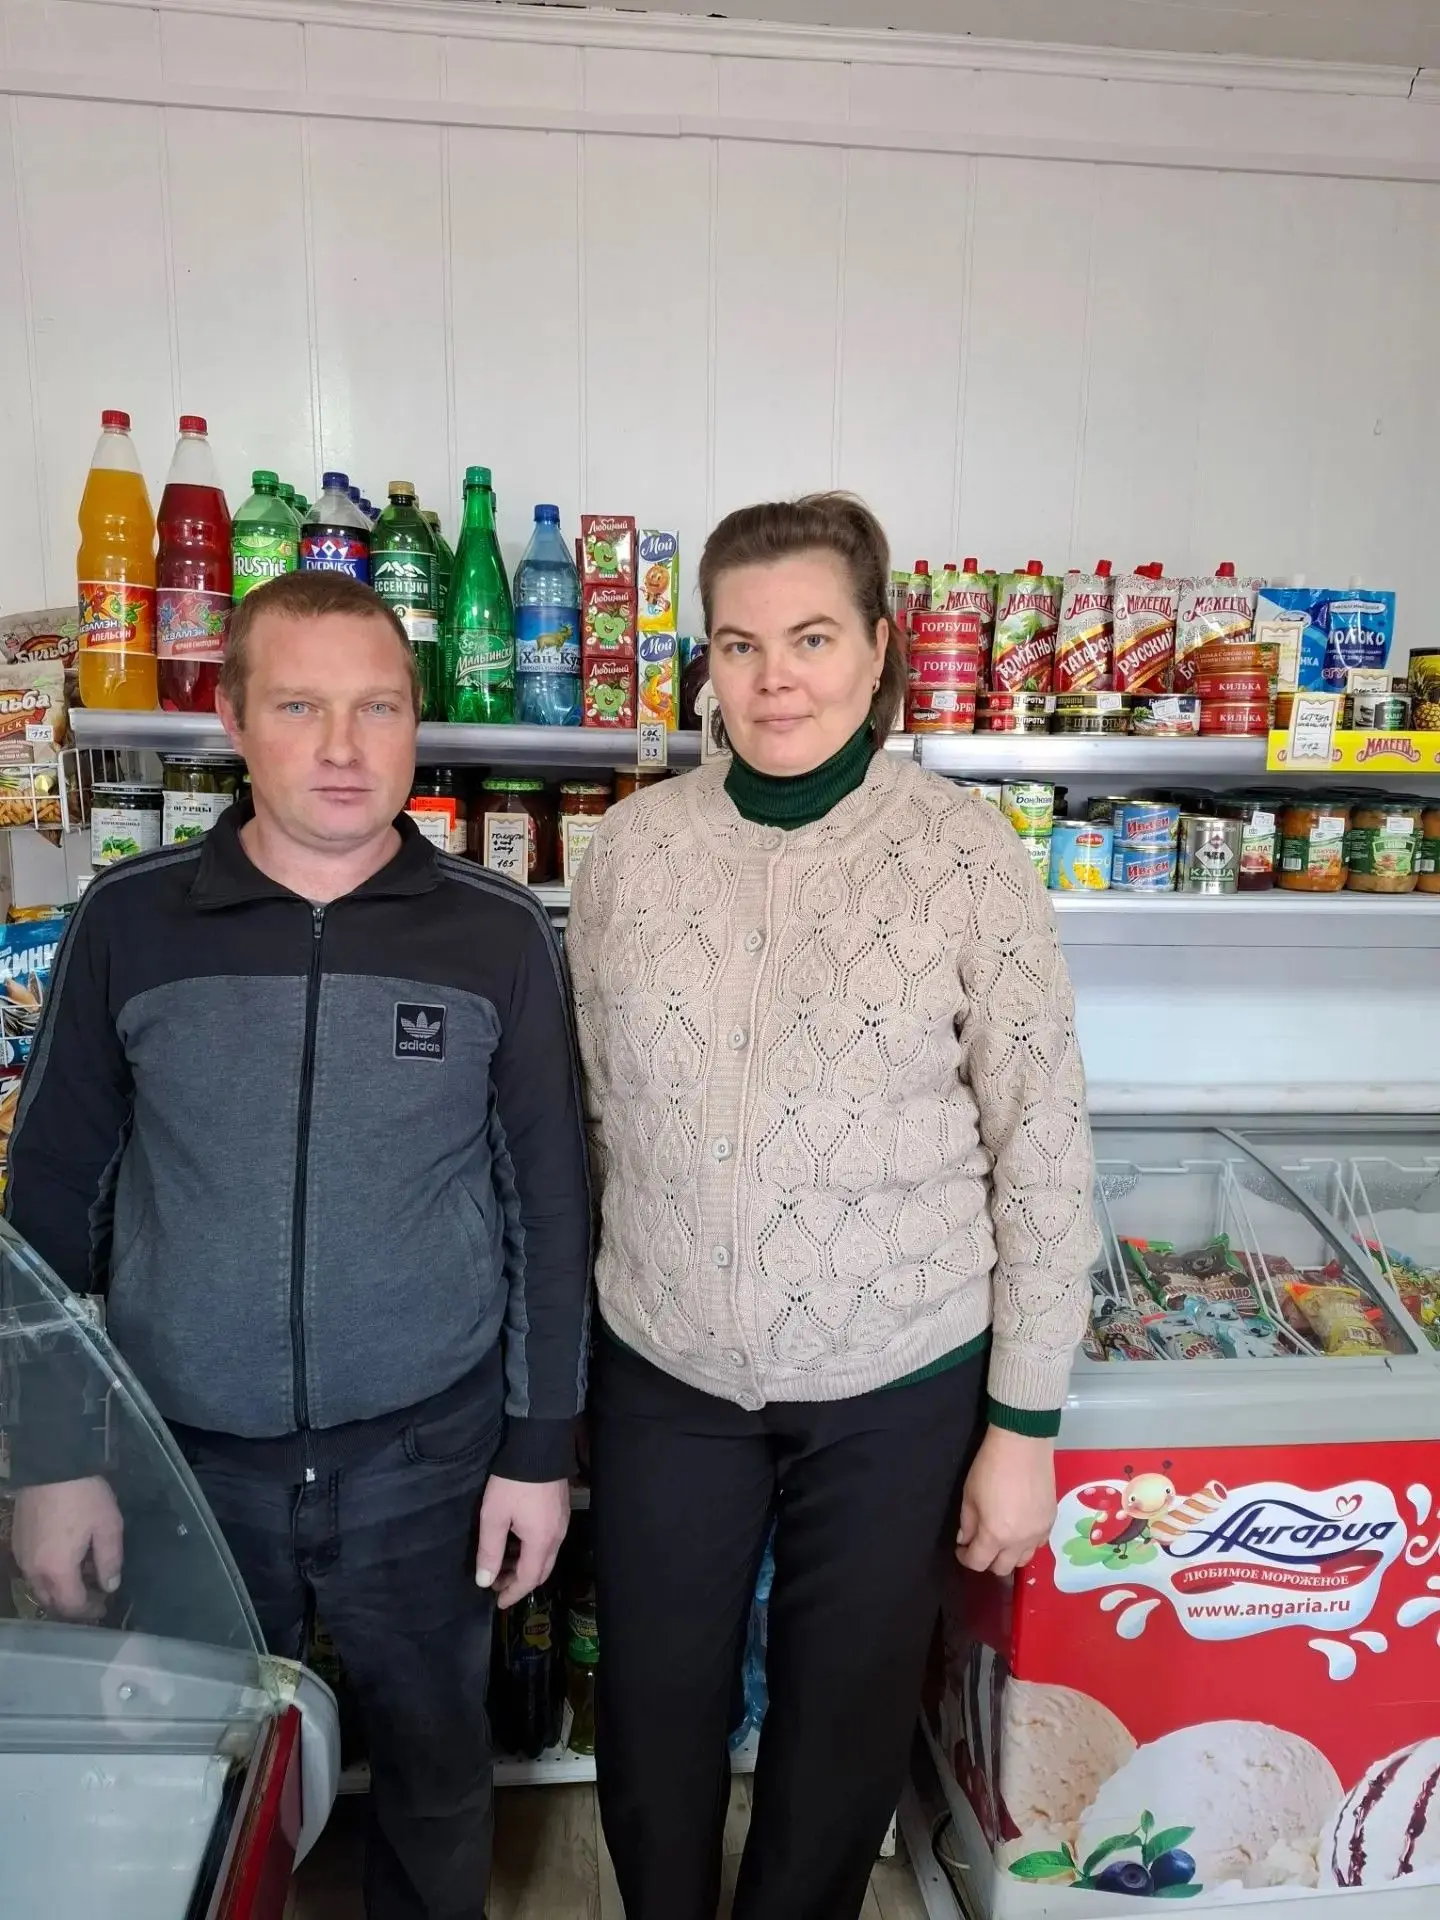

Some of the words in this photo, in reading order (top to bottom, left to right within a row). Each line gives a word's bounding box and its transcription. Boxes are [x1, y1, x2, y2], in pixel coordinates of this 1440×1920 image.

[641, 538, 673, 555] Мой
[374, 581, 428, 593] ЕССЕНТУКИ
[1000, 593, 1057, 620] МАХЕЕВЪ
[1115, 595, 1173, 620] МАХЕЕВЪ
[1183, 597, 1252, 622] МАХЕЕВЪ
[921, 622, 977, 633] ГОРБУША
[90, 630, 131, 642] АПЕЛЬСИН
[641, 639, 673, 656] Мой
[1117, 628, 1175, 675] РУССКИЙ
[924, 662, 977, 672] ГОРБУША
[1219, 683, 1261, 691] КИЛЬКА
[0, 690, 51, 713] льба
[1, 718, 30, 733] ICKS
[1220, 713, 1261, 722] КИЛЬКА
[645, 748, 658, 757] 33
[1356, 738, 1421, 763] МАХЕЕВЪ
[497, 859, 518, 868] 165
[1190, 868, 1234, 877] КАША
[399, 1040, 441, 1052] adidas
[1184, 1499, 1398, 1560] Ангария
[1183, 1567, 1260, 1583] ЛЮБИМОЕ
[1261, 1570, 1350, 1587] МОРОЖЕНОЕ
[1187, 1598, 1351, 1619] www.angaria.ru
